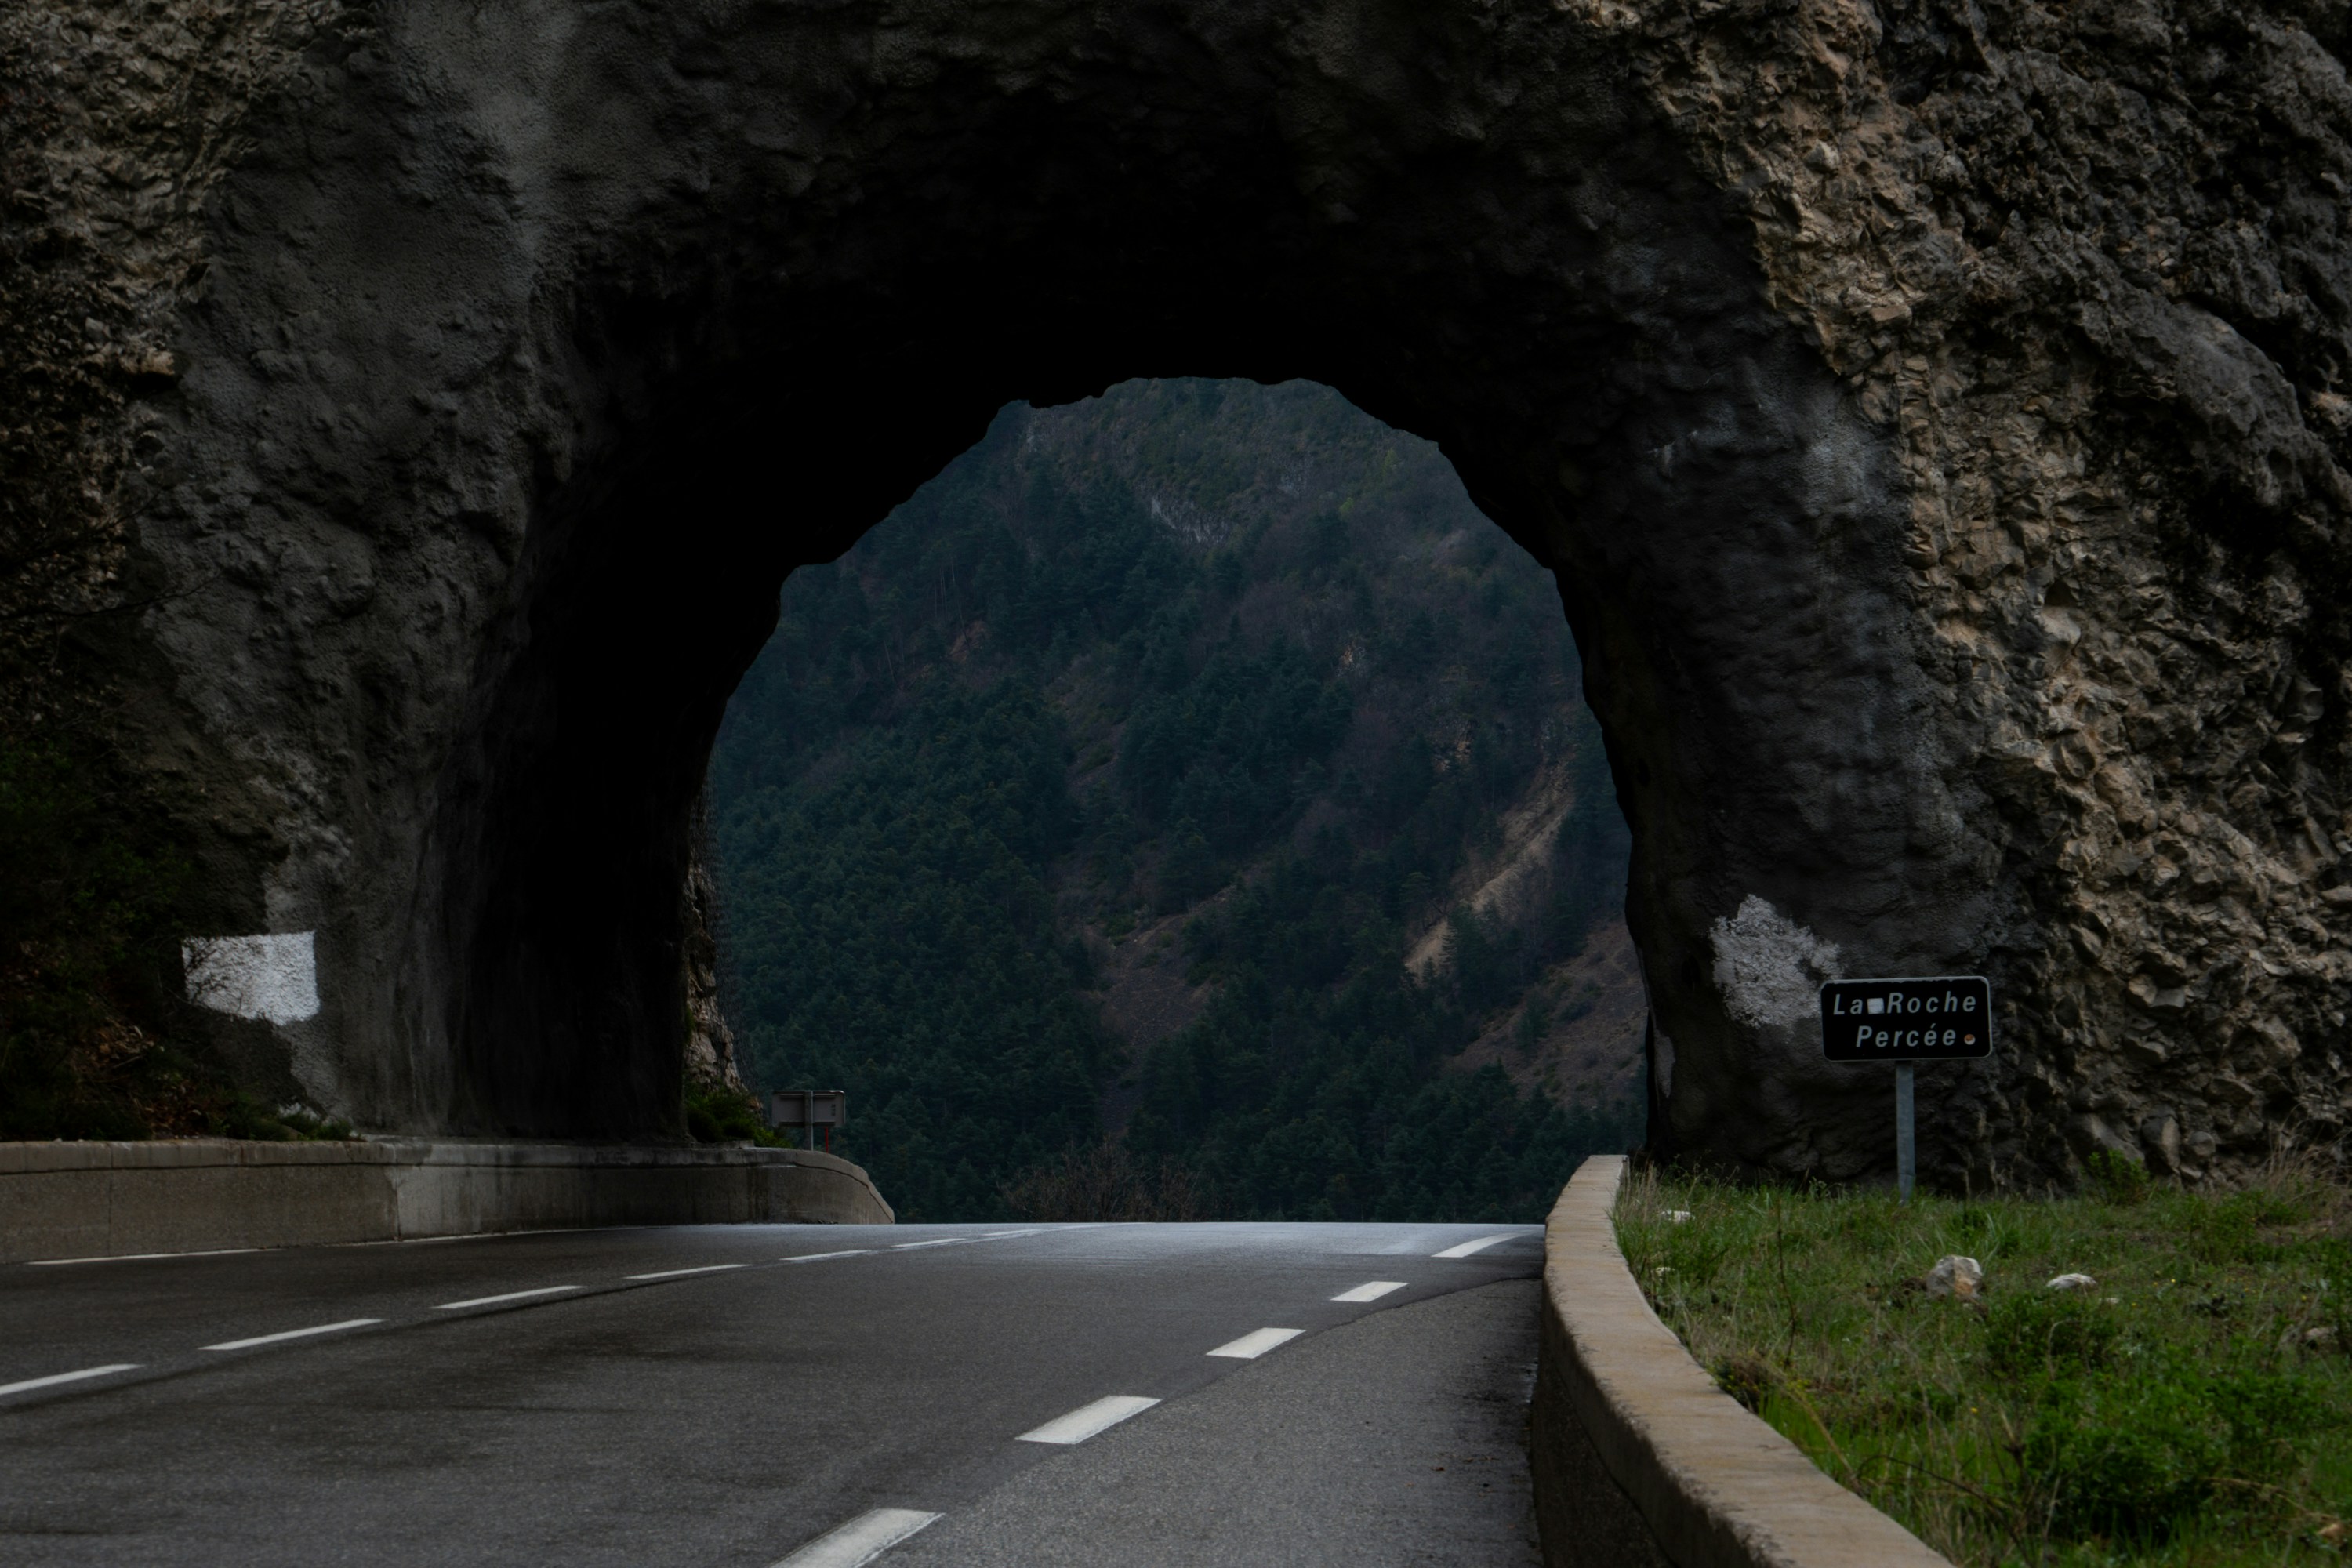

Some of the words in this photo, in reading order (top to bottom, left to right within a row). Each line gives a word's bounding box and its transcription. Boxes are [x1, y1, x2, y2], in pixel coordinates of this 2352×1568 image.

[1833, 993, 1863, 1015] La
[1886, 990, 1976, 1014] Roche
[1856, 1022, 1956, 1047] Percée
